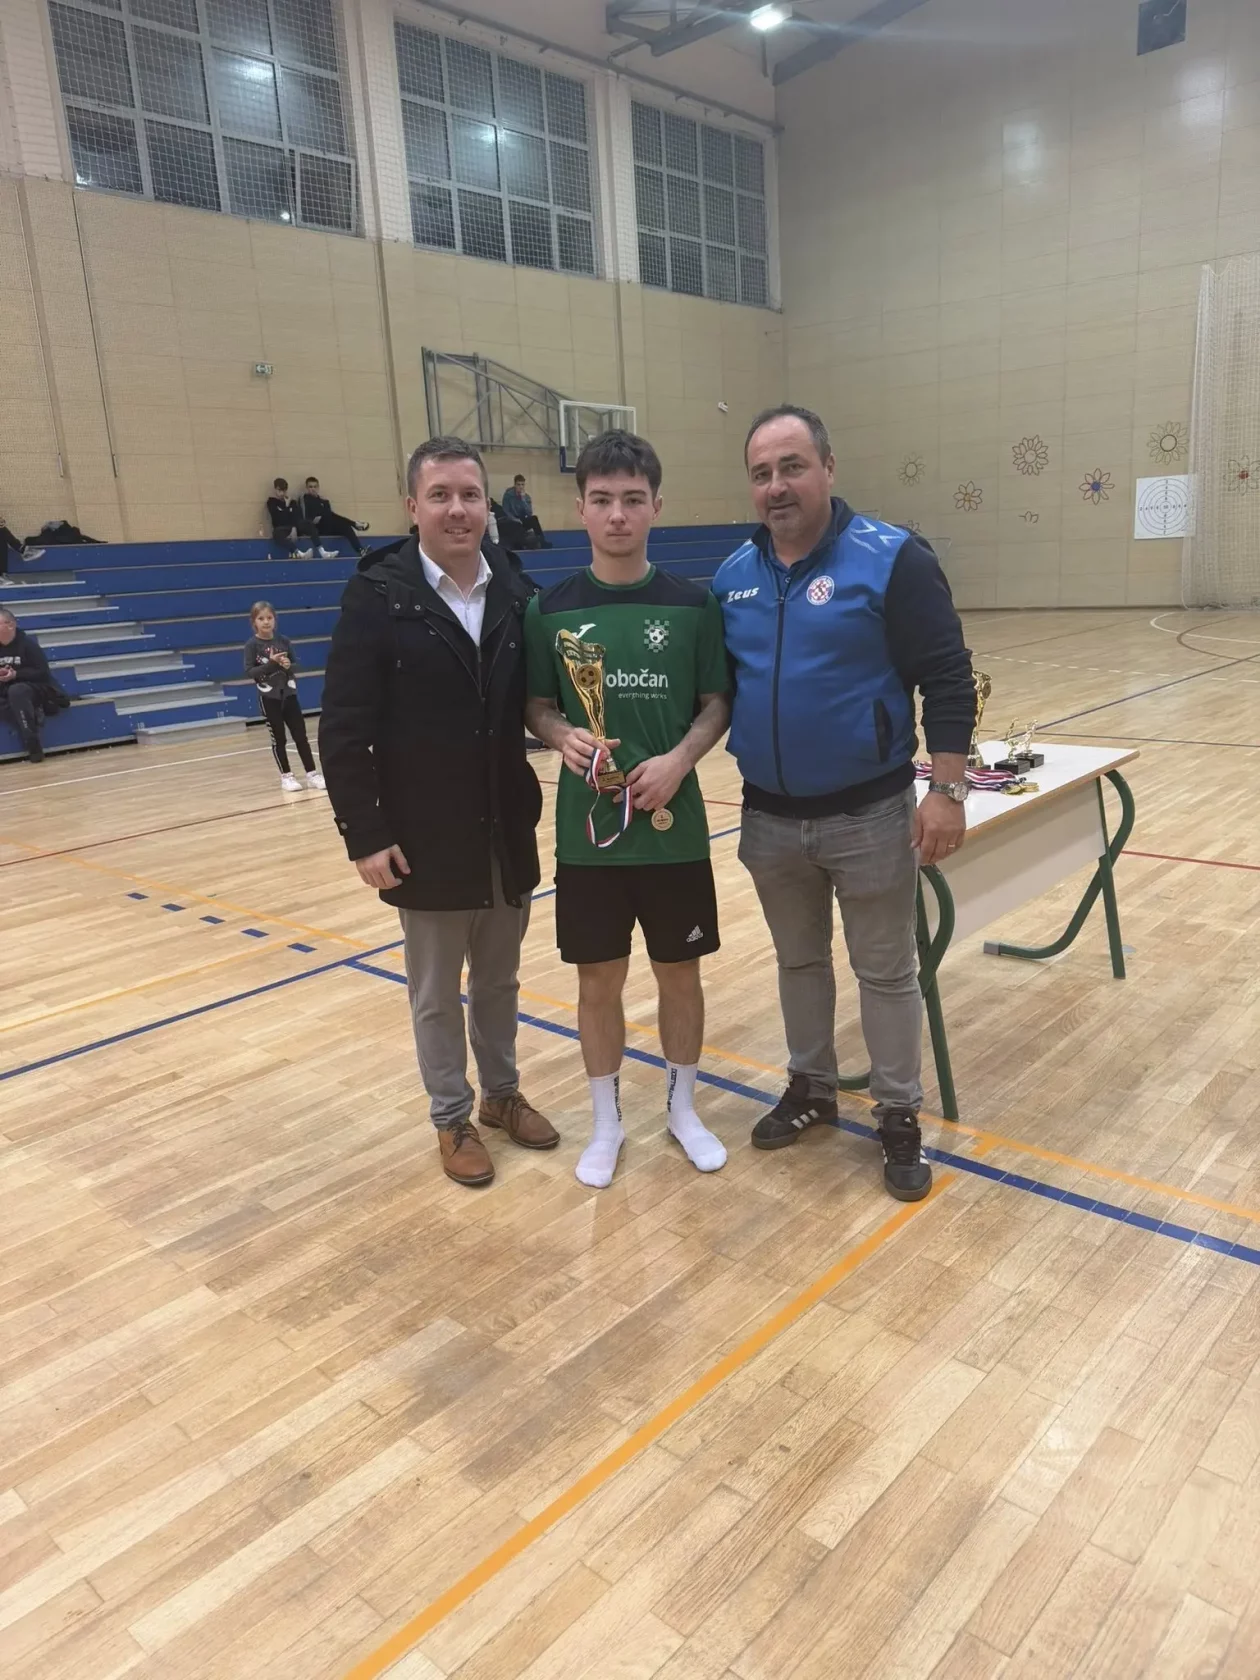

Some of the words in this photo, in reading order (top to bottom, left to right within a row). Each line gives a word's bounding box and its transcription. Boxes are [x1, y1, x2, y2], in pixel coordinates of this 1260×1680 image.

[726, 587, 759, 603] Zeus
[604, 668, 669, 688] obočan
[618, 692, 649, 700] everything
[650, 692, 667, 700] works
